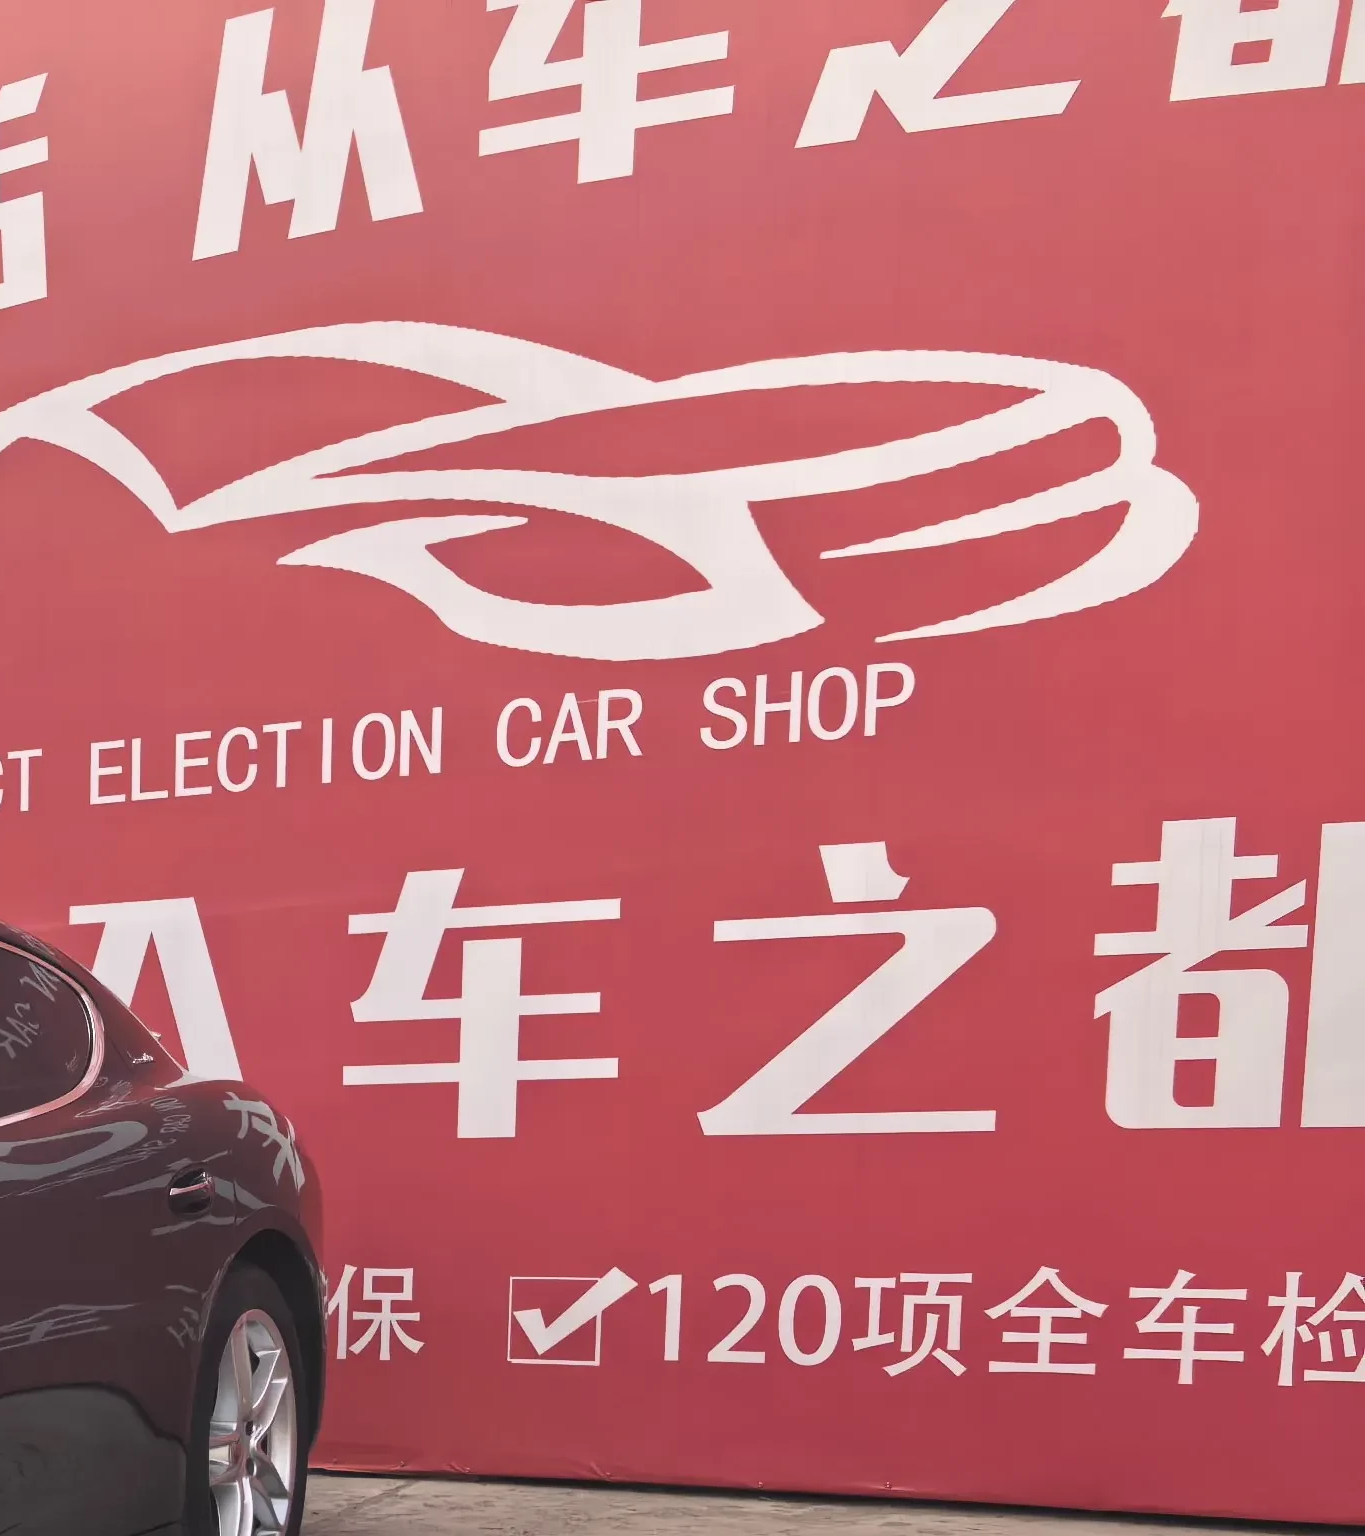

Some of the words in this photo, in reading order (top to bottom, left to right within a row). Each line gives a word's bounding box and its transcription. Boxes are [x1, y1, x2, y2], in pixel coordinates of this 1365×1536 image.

[88, 706, 444, 806] ELECTION
[495, 688, 644, 768] CAR
[699, 662, 916, 751] SHOP
